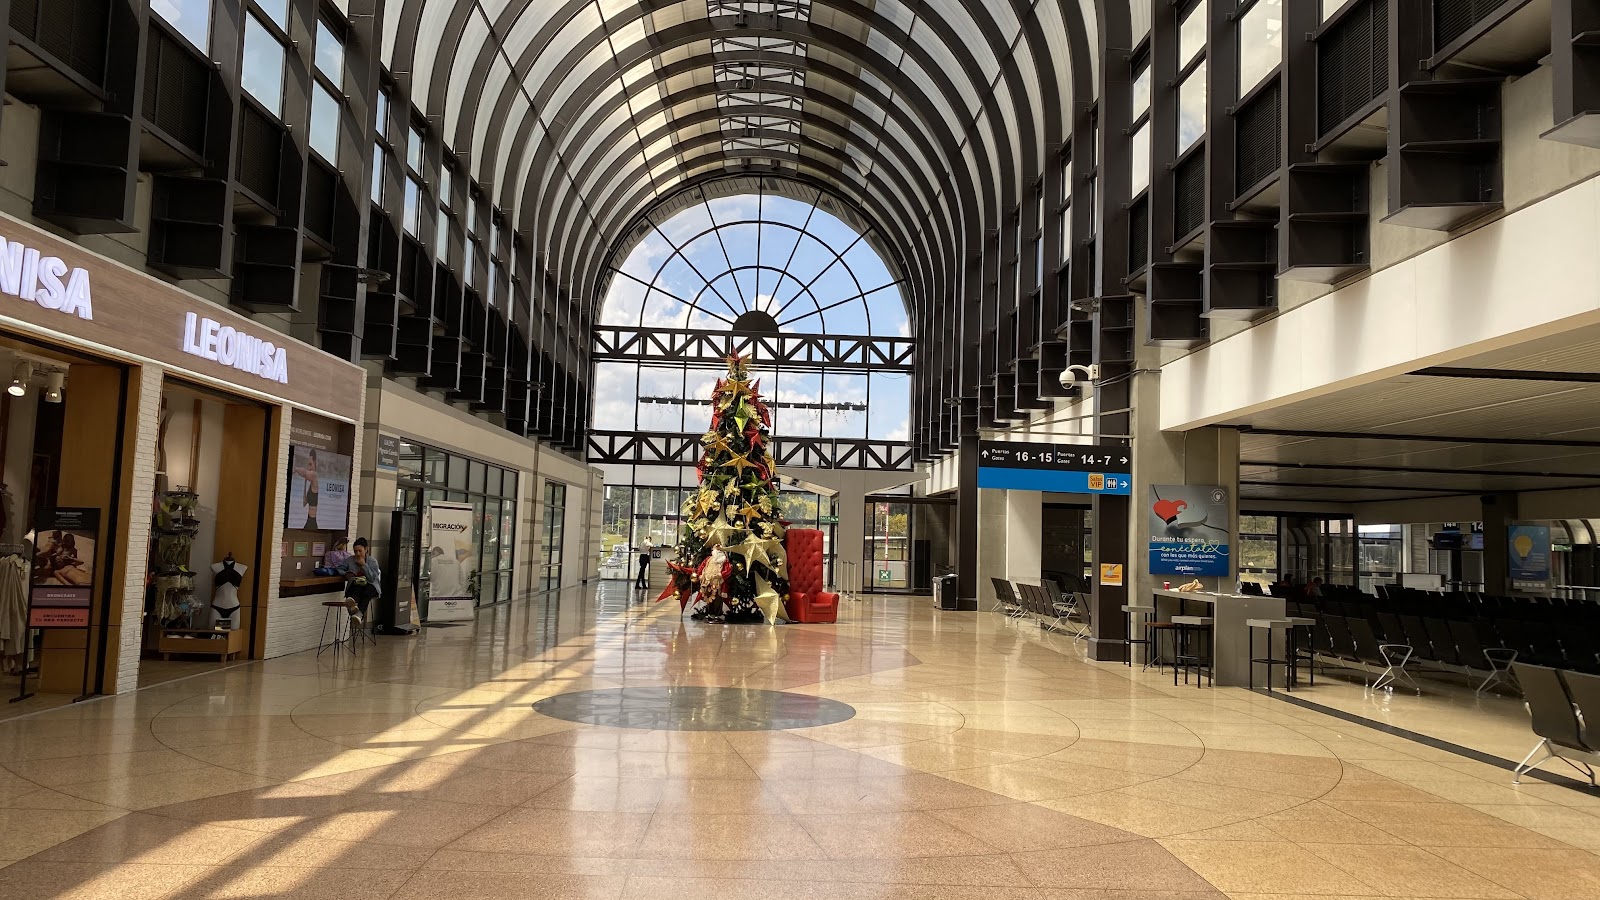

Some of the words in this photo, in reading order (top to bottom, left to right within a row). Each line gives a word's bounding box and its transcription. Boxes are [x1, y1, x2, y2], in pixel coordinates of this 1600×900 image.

[183, 311, 288, 384] LEONISA
[1016, 452, 1028, 461] 16
[1039, 452, 1052, 462] 15
[1081, 454, 1094, 465] 14
[1104, 456, 1111, 465] 7
